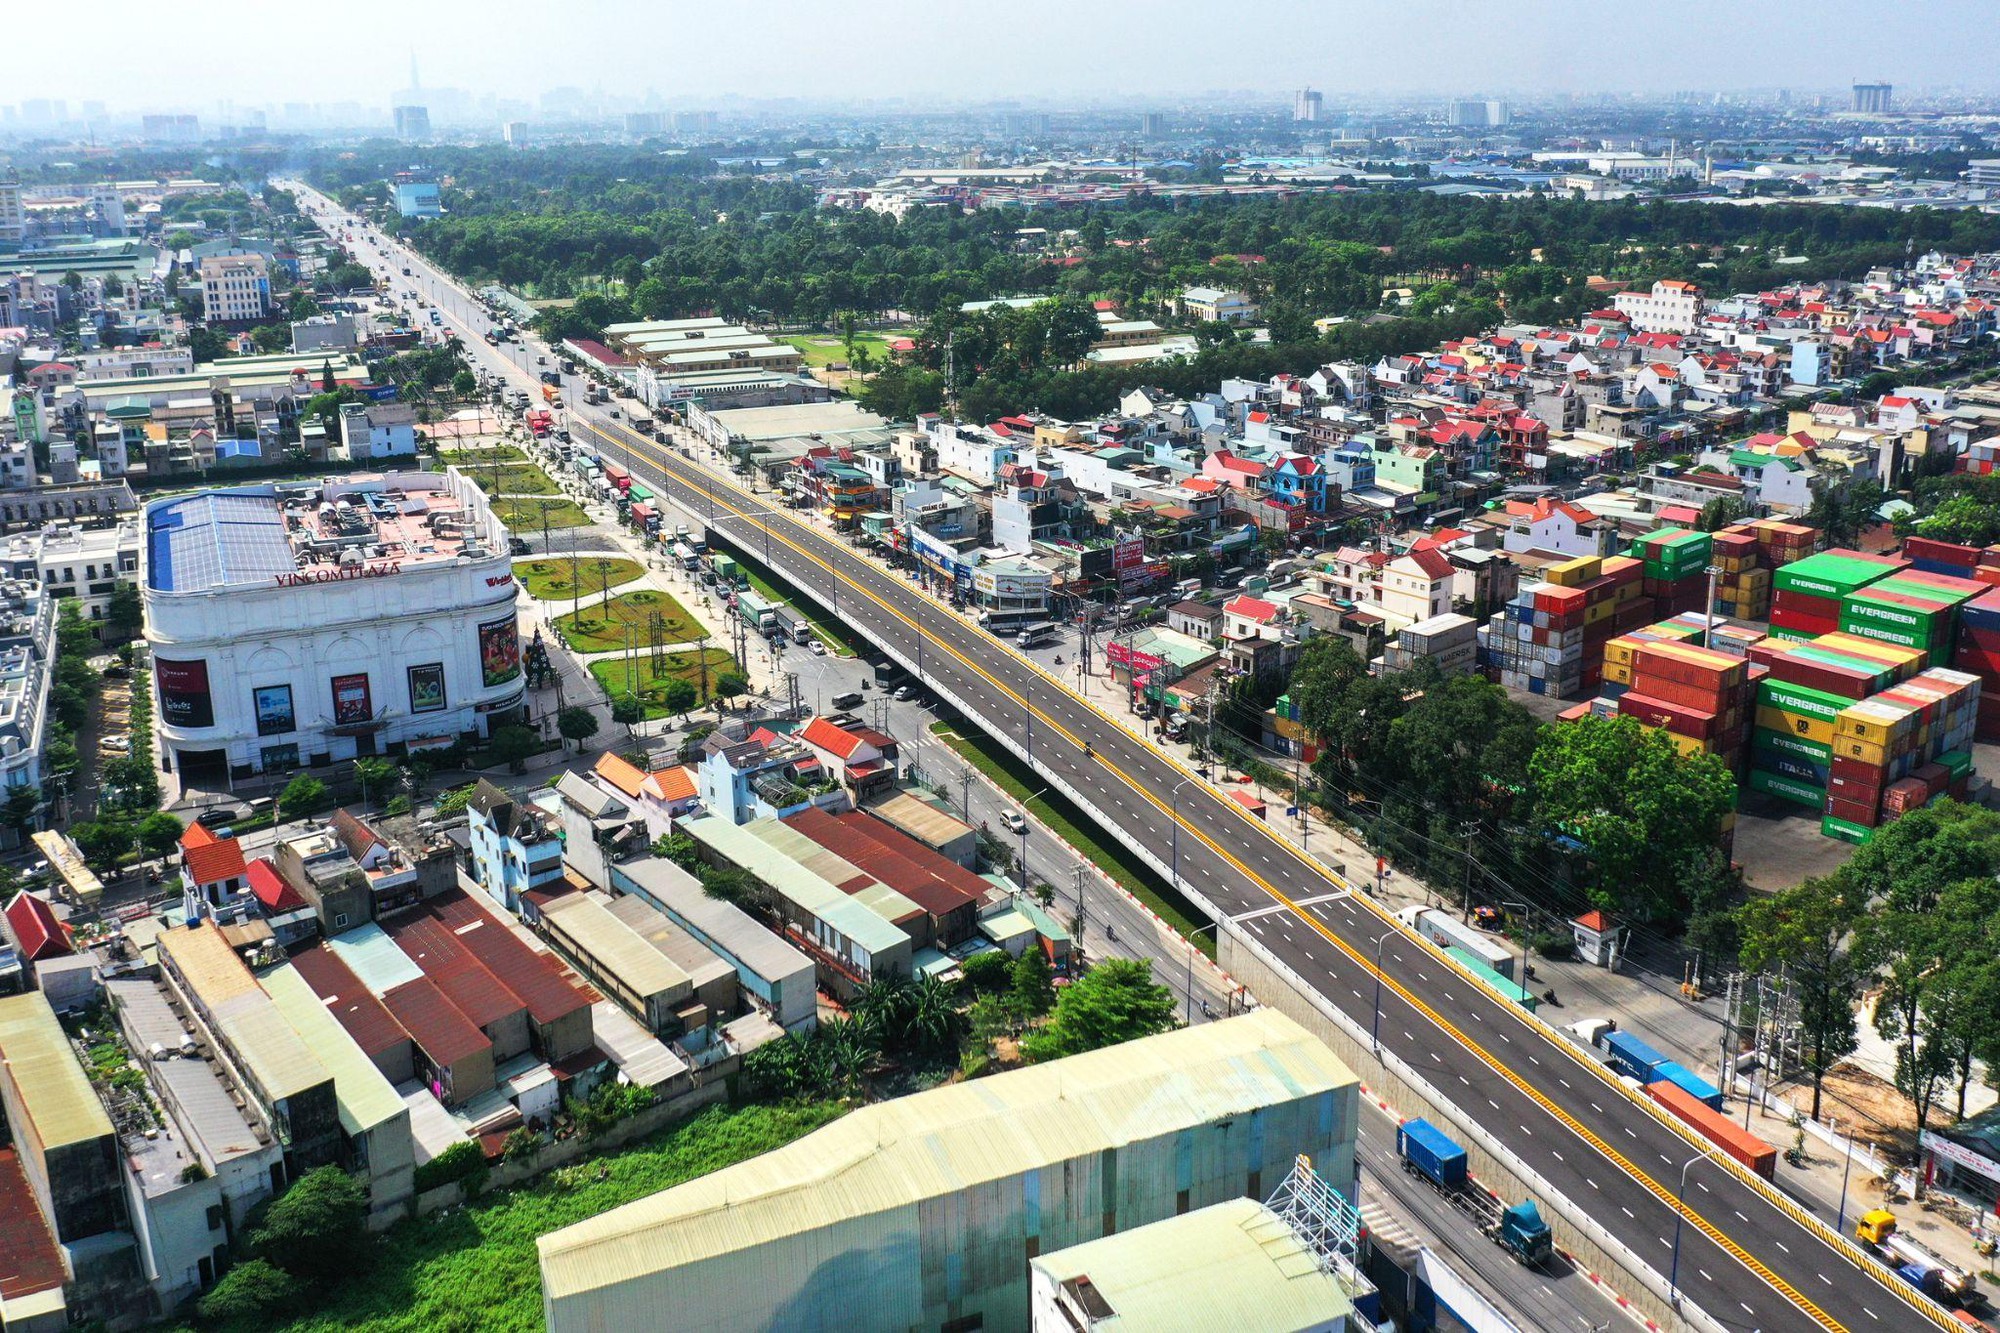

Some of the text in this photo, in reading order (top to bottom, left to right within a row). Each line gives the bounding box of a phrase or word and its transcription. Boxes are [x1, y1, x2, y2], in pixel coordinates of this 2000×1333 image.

[274, 561, 401, 588] VINCOM PLAZA
[1790, 578, 1837, 594] EVERGREEN
[1851, 604, 1917, 625] EVERGREEN
[1848, 624, 1914, 645] EVERGREEN
[1770, 691, 1840, 717] EVERGREEN
[1773, 737, 1827, 759] EVERGREEN
[1767, 780, 1819, 800] EVERGREEN
